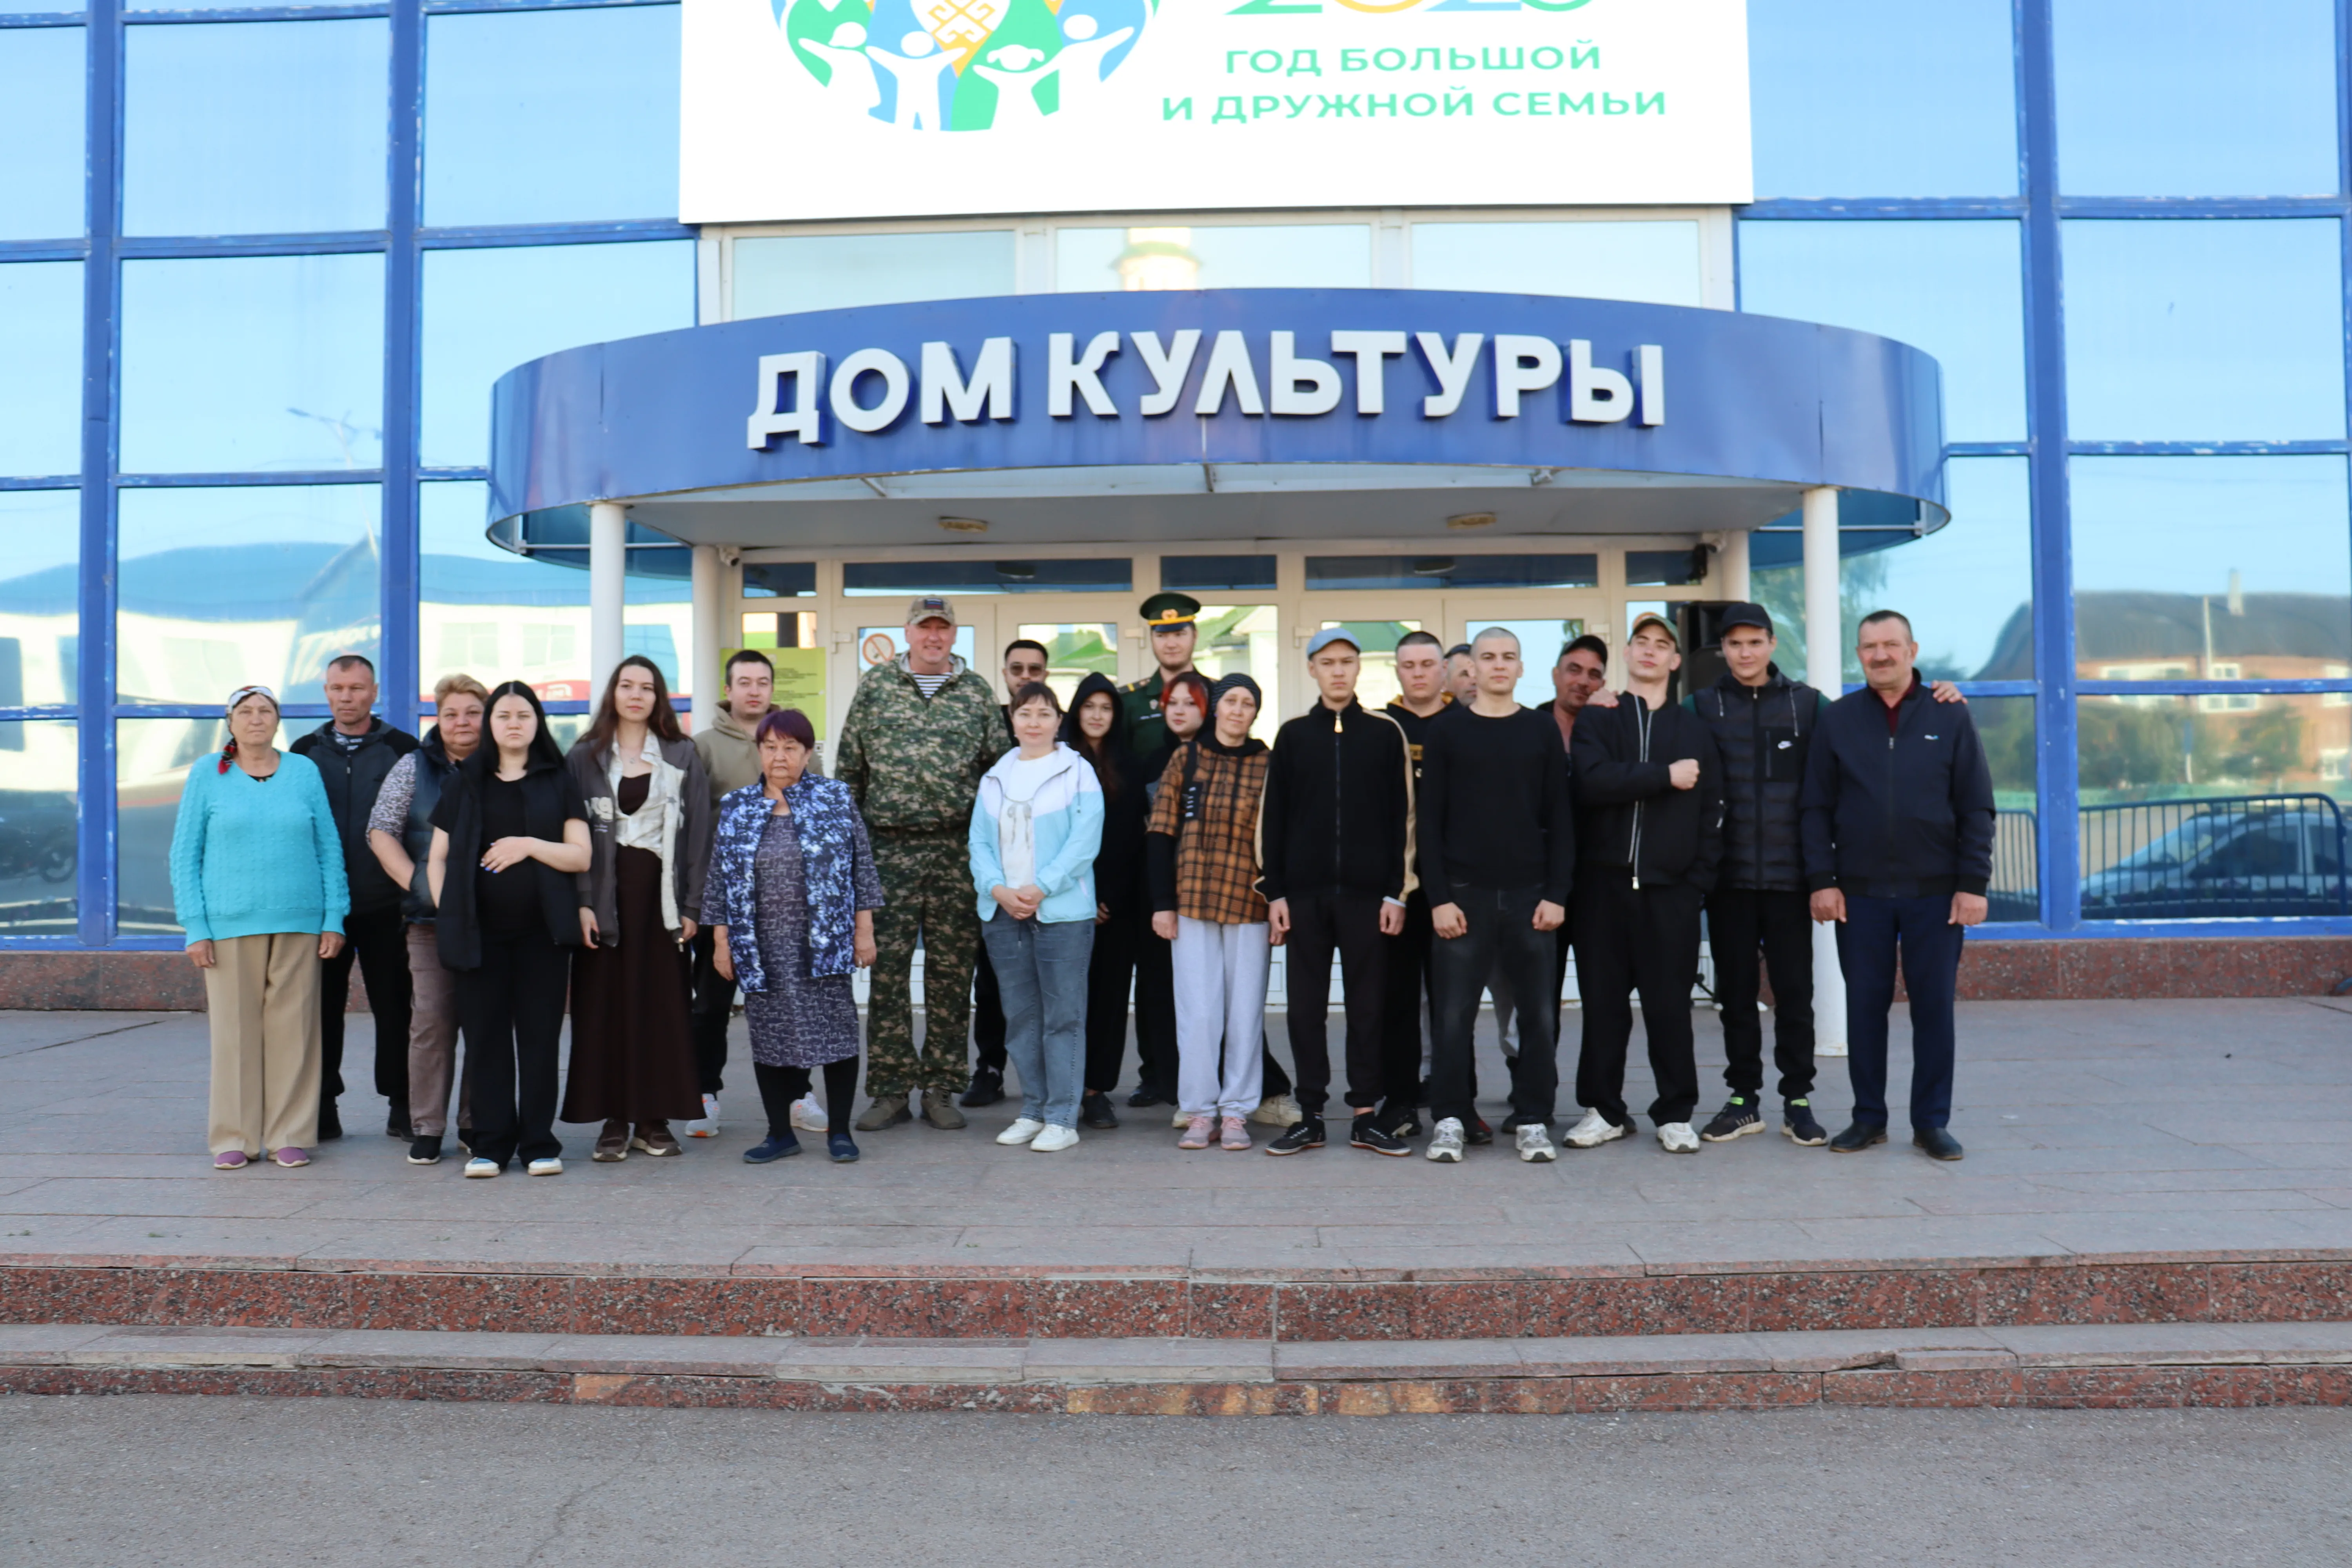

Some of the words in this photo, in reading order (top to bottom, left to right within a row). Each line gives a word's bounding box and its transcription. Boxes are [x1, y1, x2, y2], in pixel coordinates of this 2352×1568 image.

[1225, 49, 1323, 78] ГОД
[1340, 39, 1601, 72] БОЛЬШОЙ
[1162, 96, 1193, 122] И
[1211, 85, 1474, 125] ДРУЖНОЙ
[1492, 91, 1666, 116] СЕМЬИ
[747, 336, 1014, 449] ДОМ
[1048, 328, 1665, 426] КУЛЬТУРЫ
